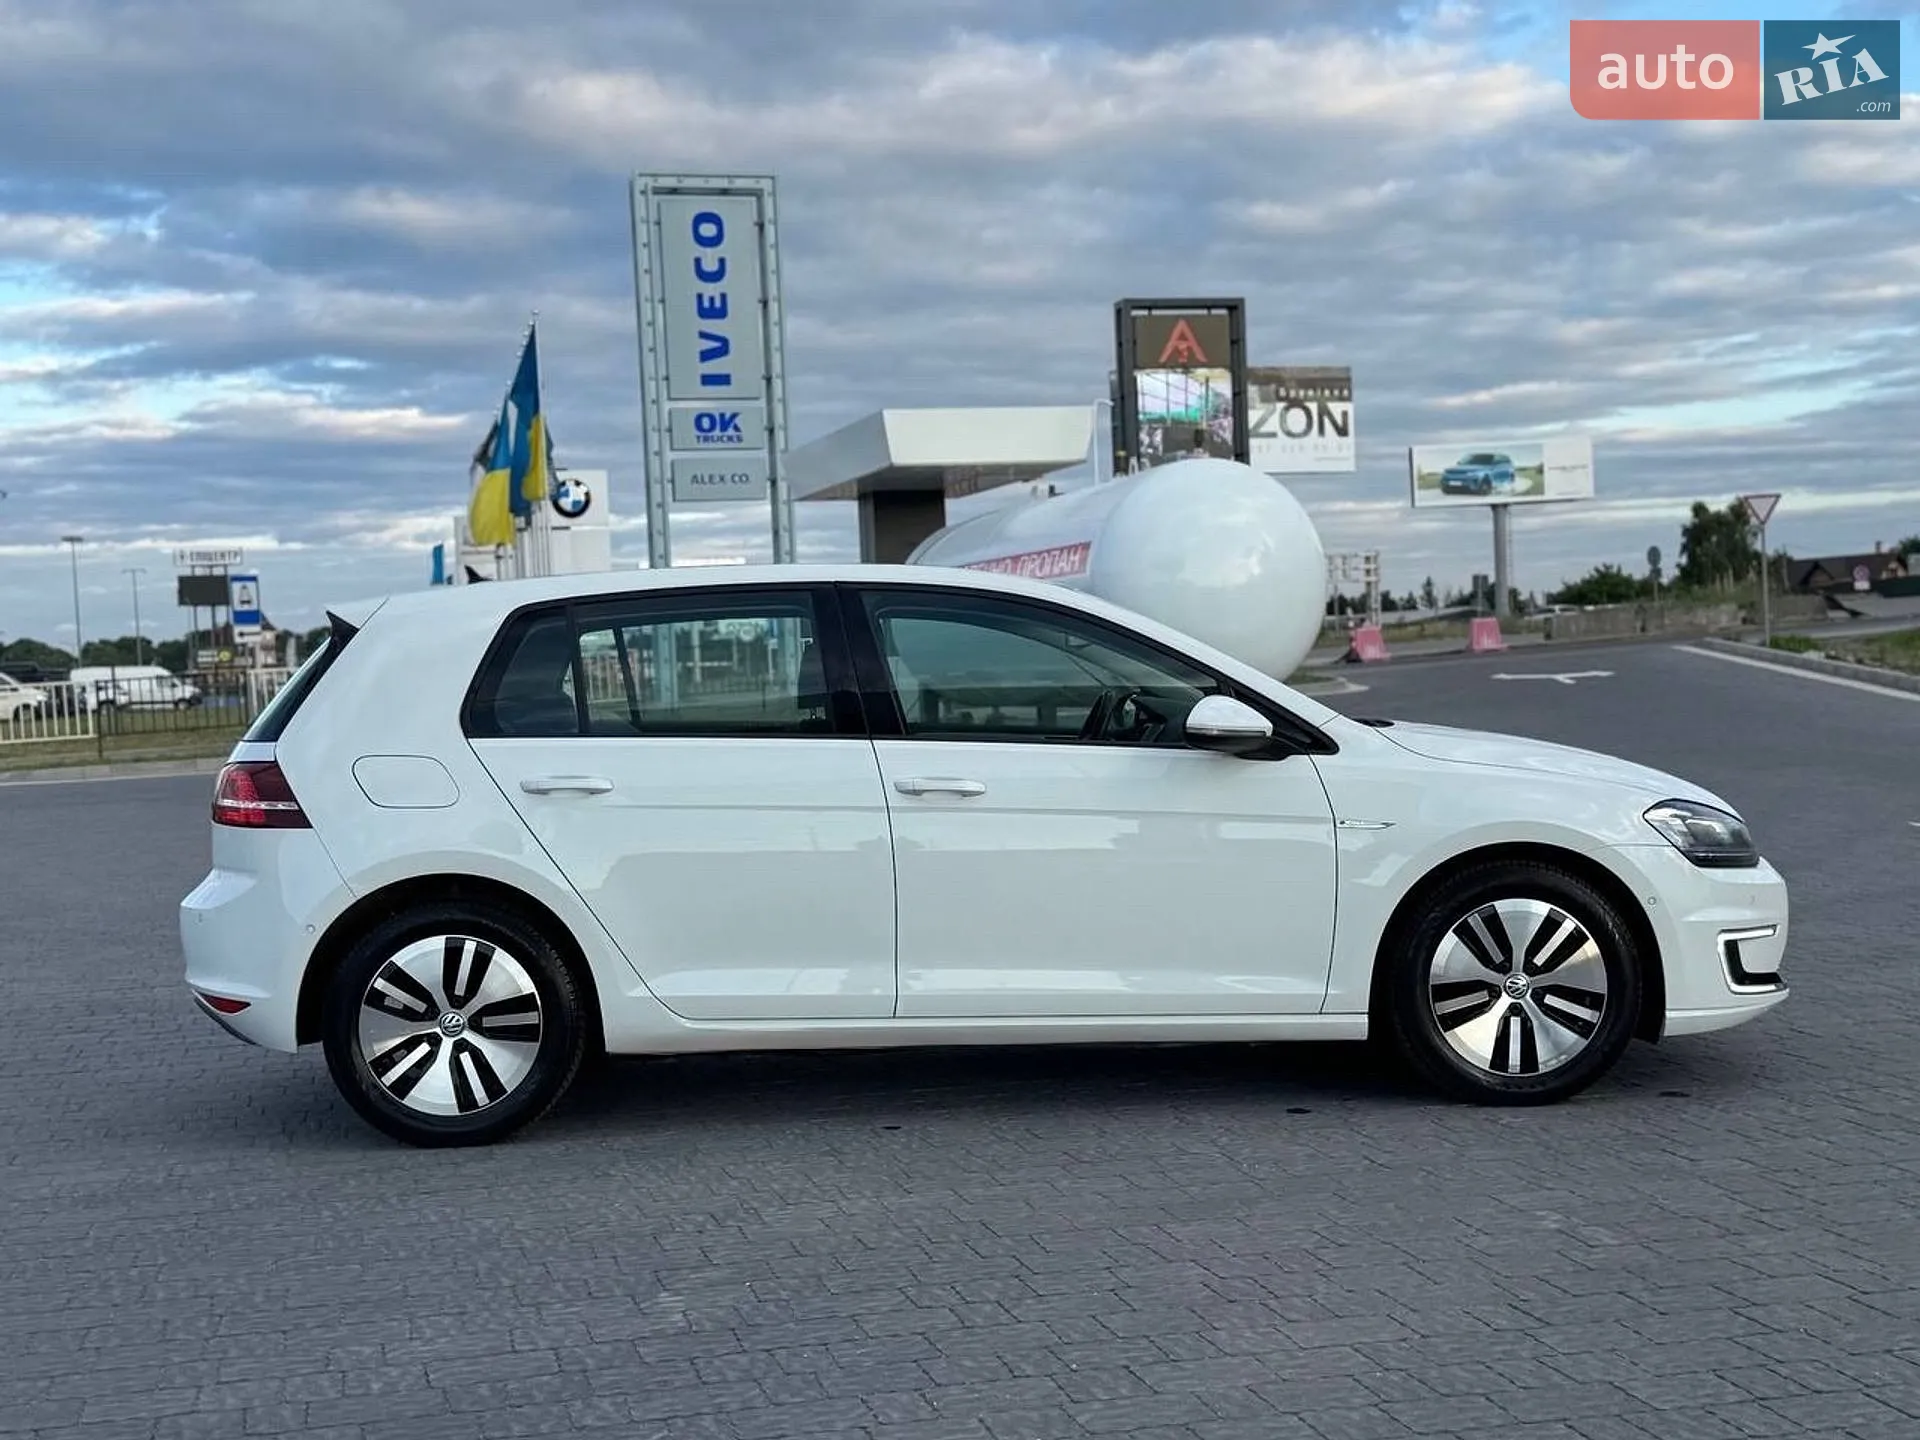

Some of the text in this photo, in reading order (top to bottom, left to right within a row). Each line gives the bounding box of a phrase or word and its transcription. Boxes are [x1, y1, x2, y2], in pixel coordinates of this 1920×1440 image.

[691, 211, 731, 386] IVECO
[694, 412, 742, 432] OK
[696, 434, 744, 444] TRUCKS
[690, 473, 726, 486] ALEX
[1017, 545, 1081, 577] ПРОПАН
